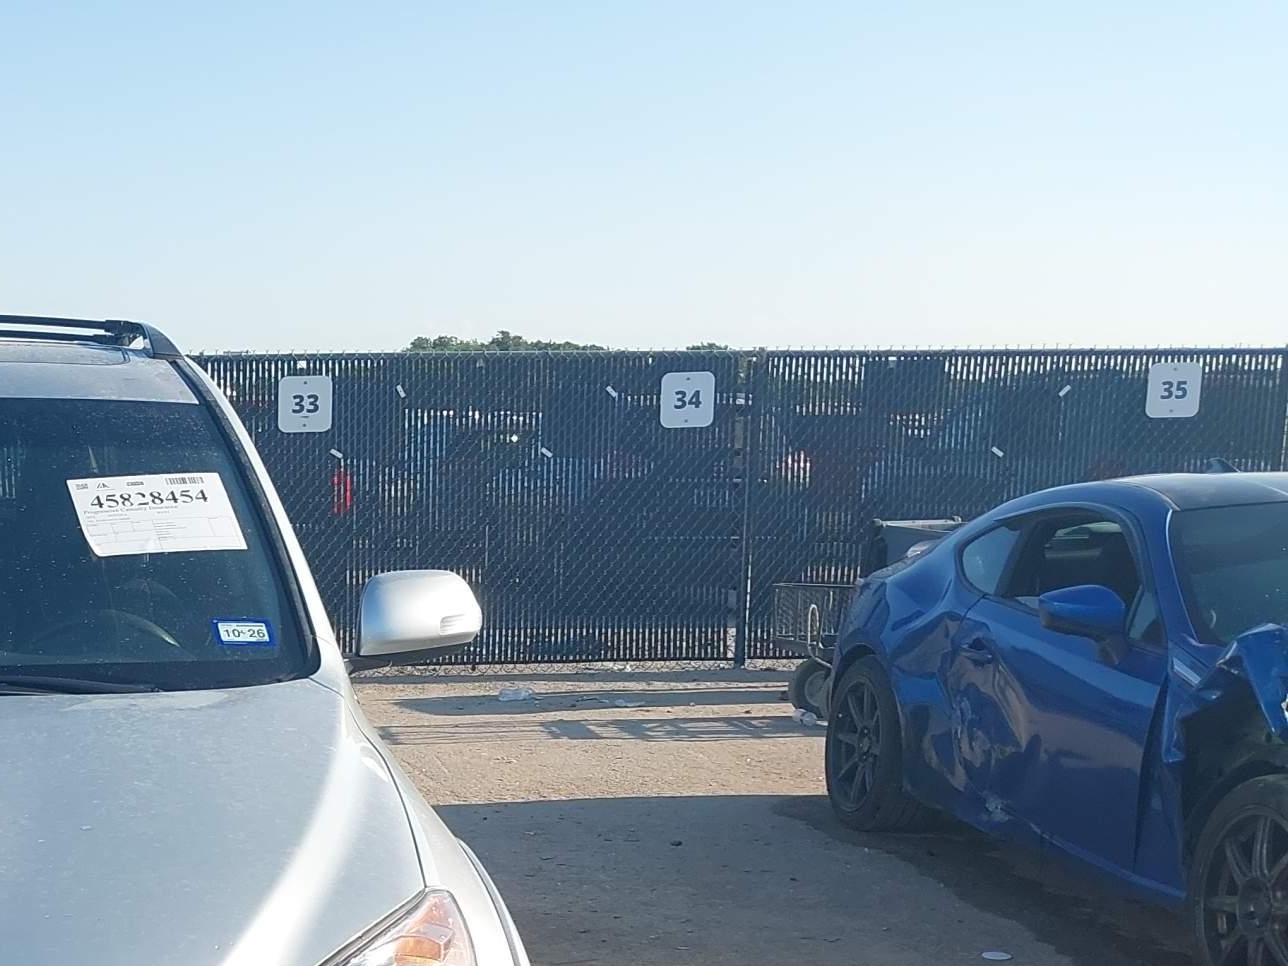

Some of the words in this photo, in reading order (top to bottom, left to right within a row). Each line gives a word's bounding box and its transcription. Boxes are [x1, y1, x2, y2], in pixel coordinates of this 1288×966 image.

[674, 390, 702, 409] 34
[1160, 380, 1188, 400] 35
[292, 394, 320, 414] 33
[90, 488, 208, 509] 45828454
